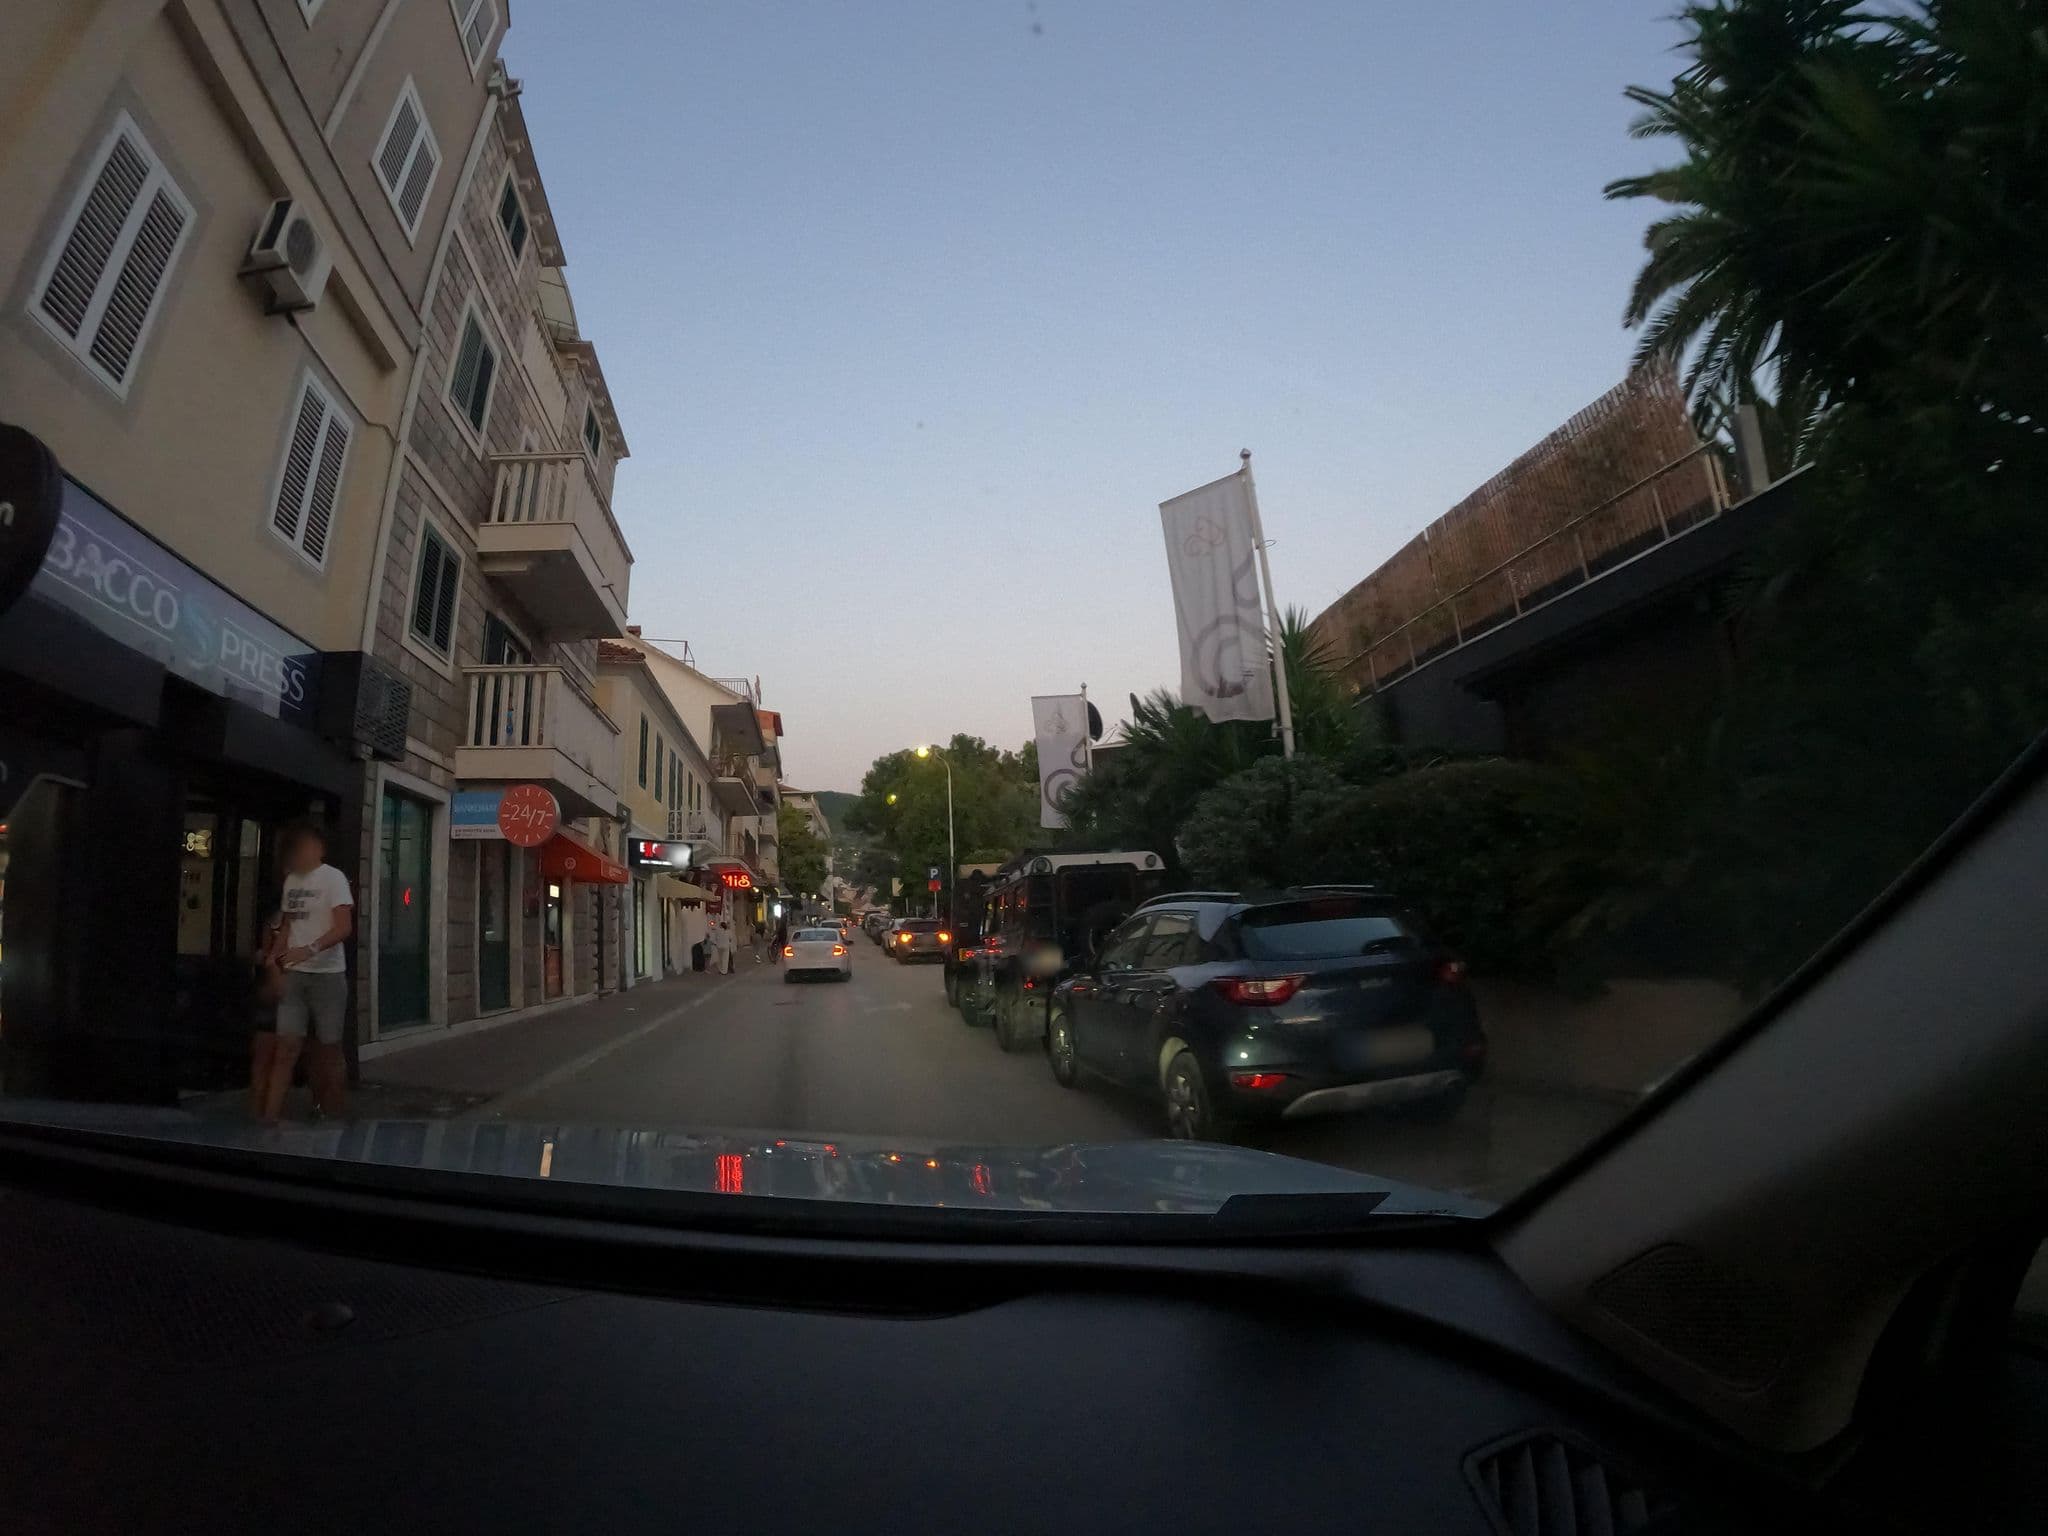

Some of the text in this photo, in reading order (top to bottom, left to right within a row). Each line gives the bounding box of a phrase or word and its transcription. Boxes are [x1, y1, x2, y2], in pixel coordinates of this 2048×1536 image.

[221, 630, 304, 702] PRESS
[510, 804, 546, 827] 24/7
[930, 868, 939, 879] P
